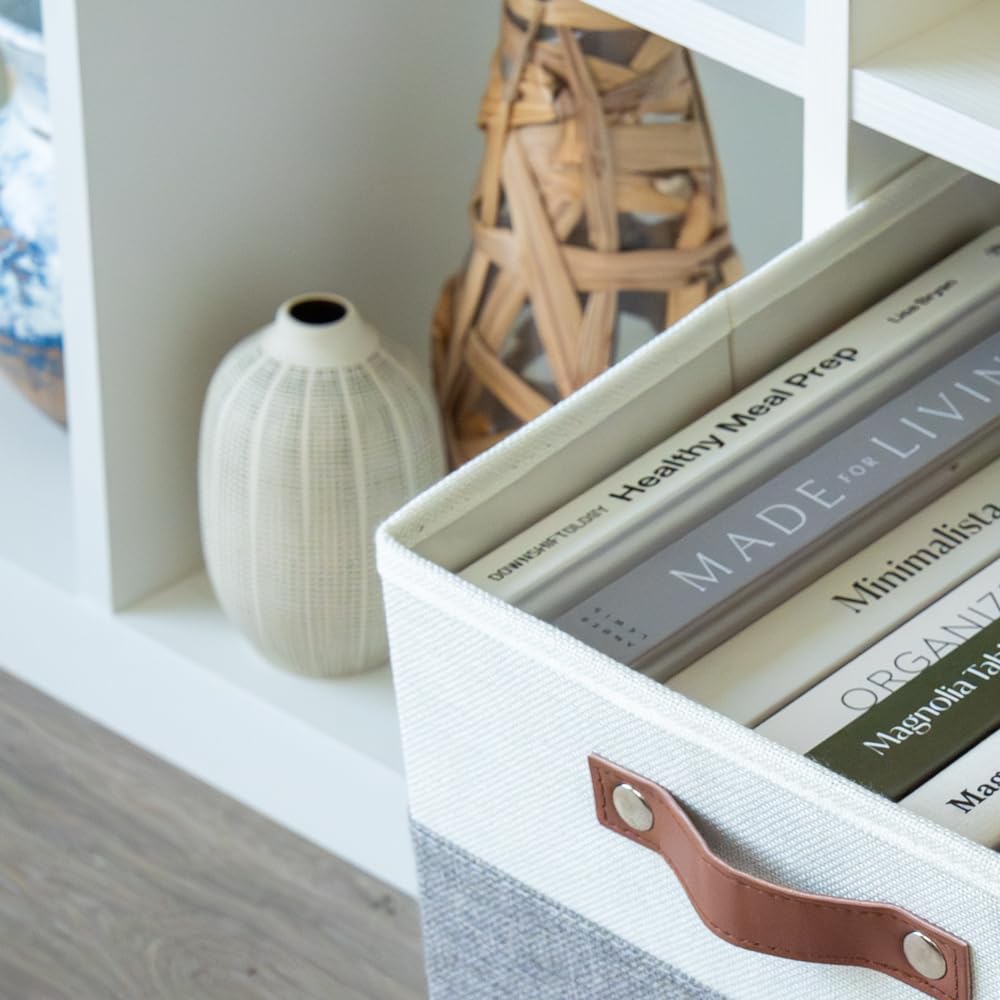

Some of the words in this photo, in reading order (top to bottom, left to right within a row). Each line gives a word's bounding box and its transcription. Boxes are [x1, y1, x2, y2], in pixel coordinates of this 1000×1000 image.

[488, 504, 609, 581] DOWNSHIFTOLOGY
[610, 433, 725, 502] Healthy
[716, 387, 794, 433] Meal
[784, 345, 859, 388] Prep
[669, 479, 845, 593] MADE
[839, 455, 880, 484] FOR
[863, 678, 978, 756] Magnolia
